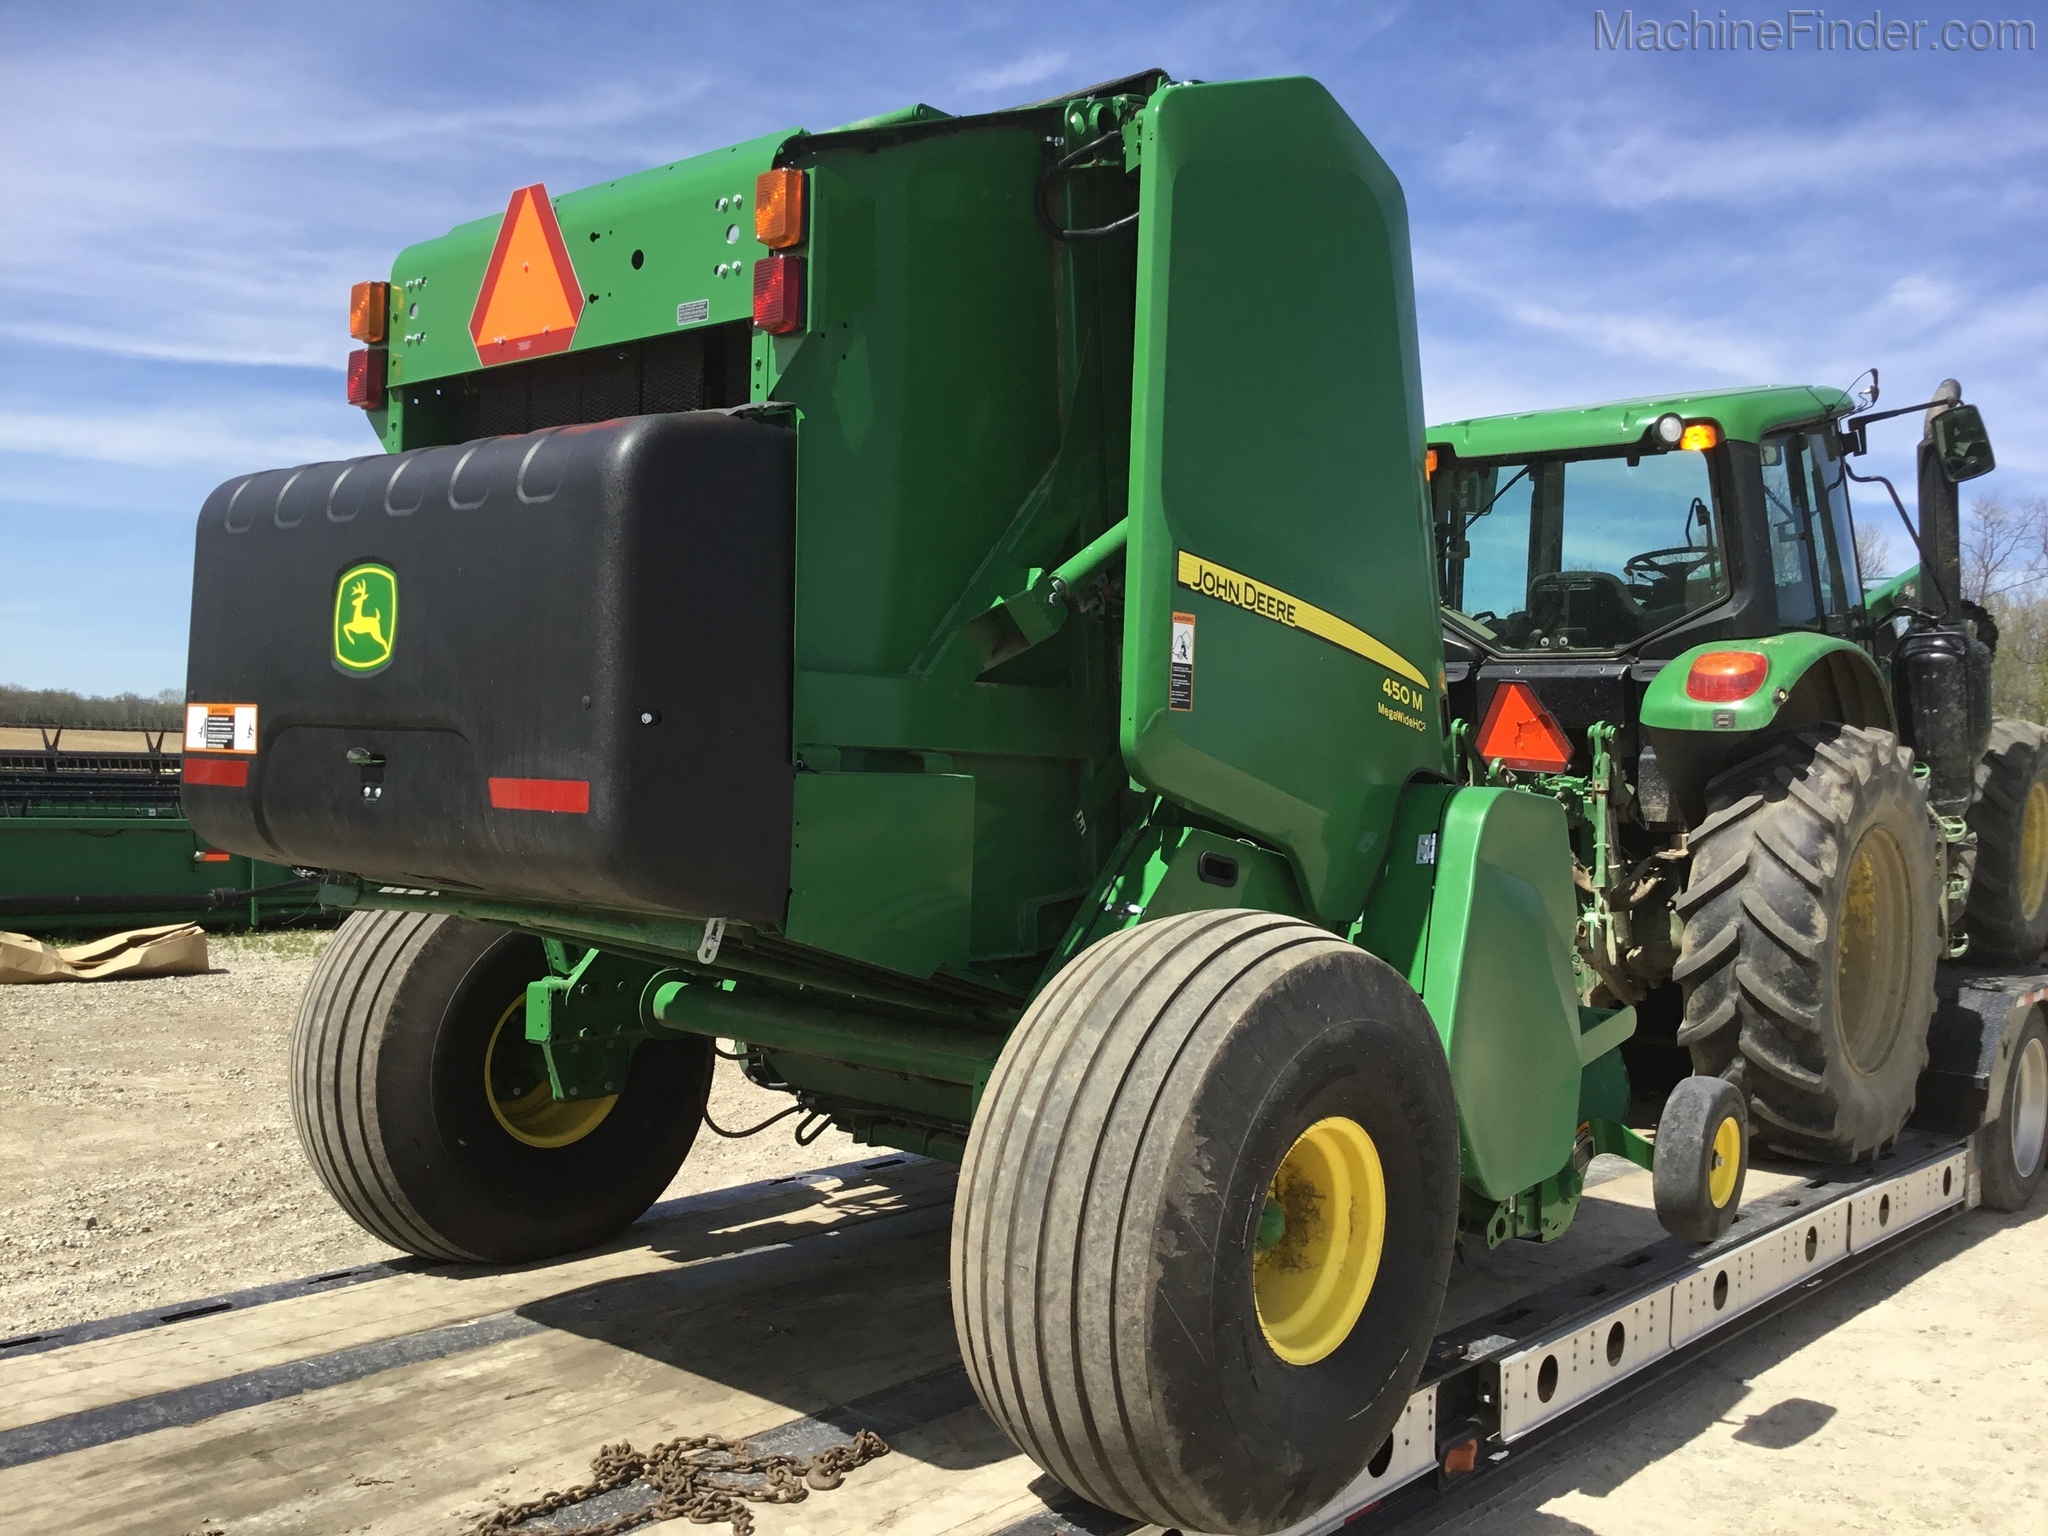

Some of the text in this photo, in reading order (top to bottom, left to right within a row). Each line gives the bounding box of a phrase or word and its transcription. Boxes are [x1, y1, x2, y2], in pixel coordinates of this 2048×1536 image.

[1193, 565, 1296, 624] JOHN DEERE
[1382, 677, 1423, 712] 450 M
